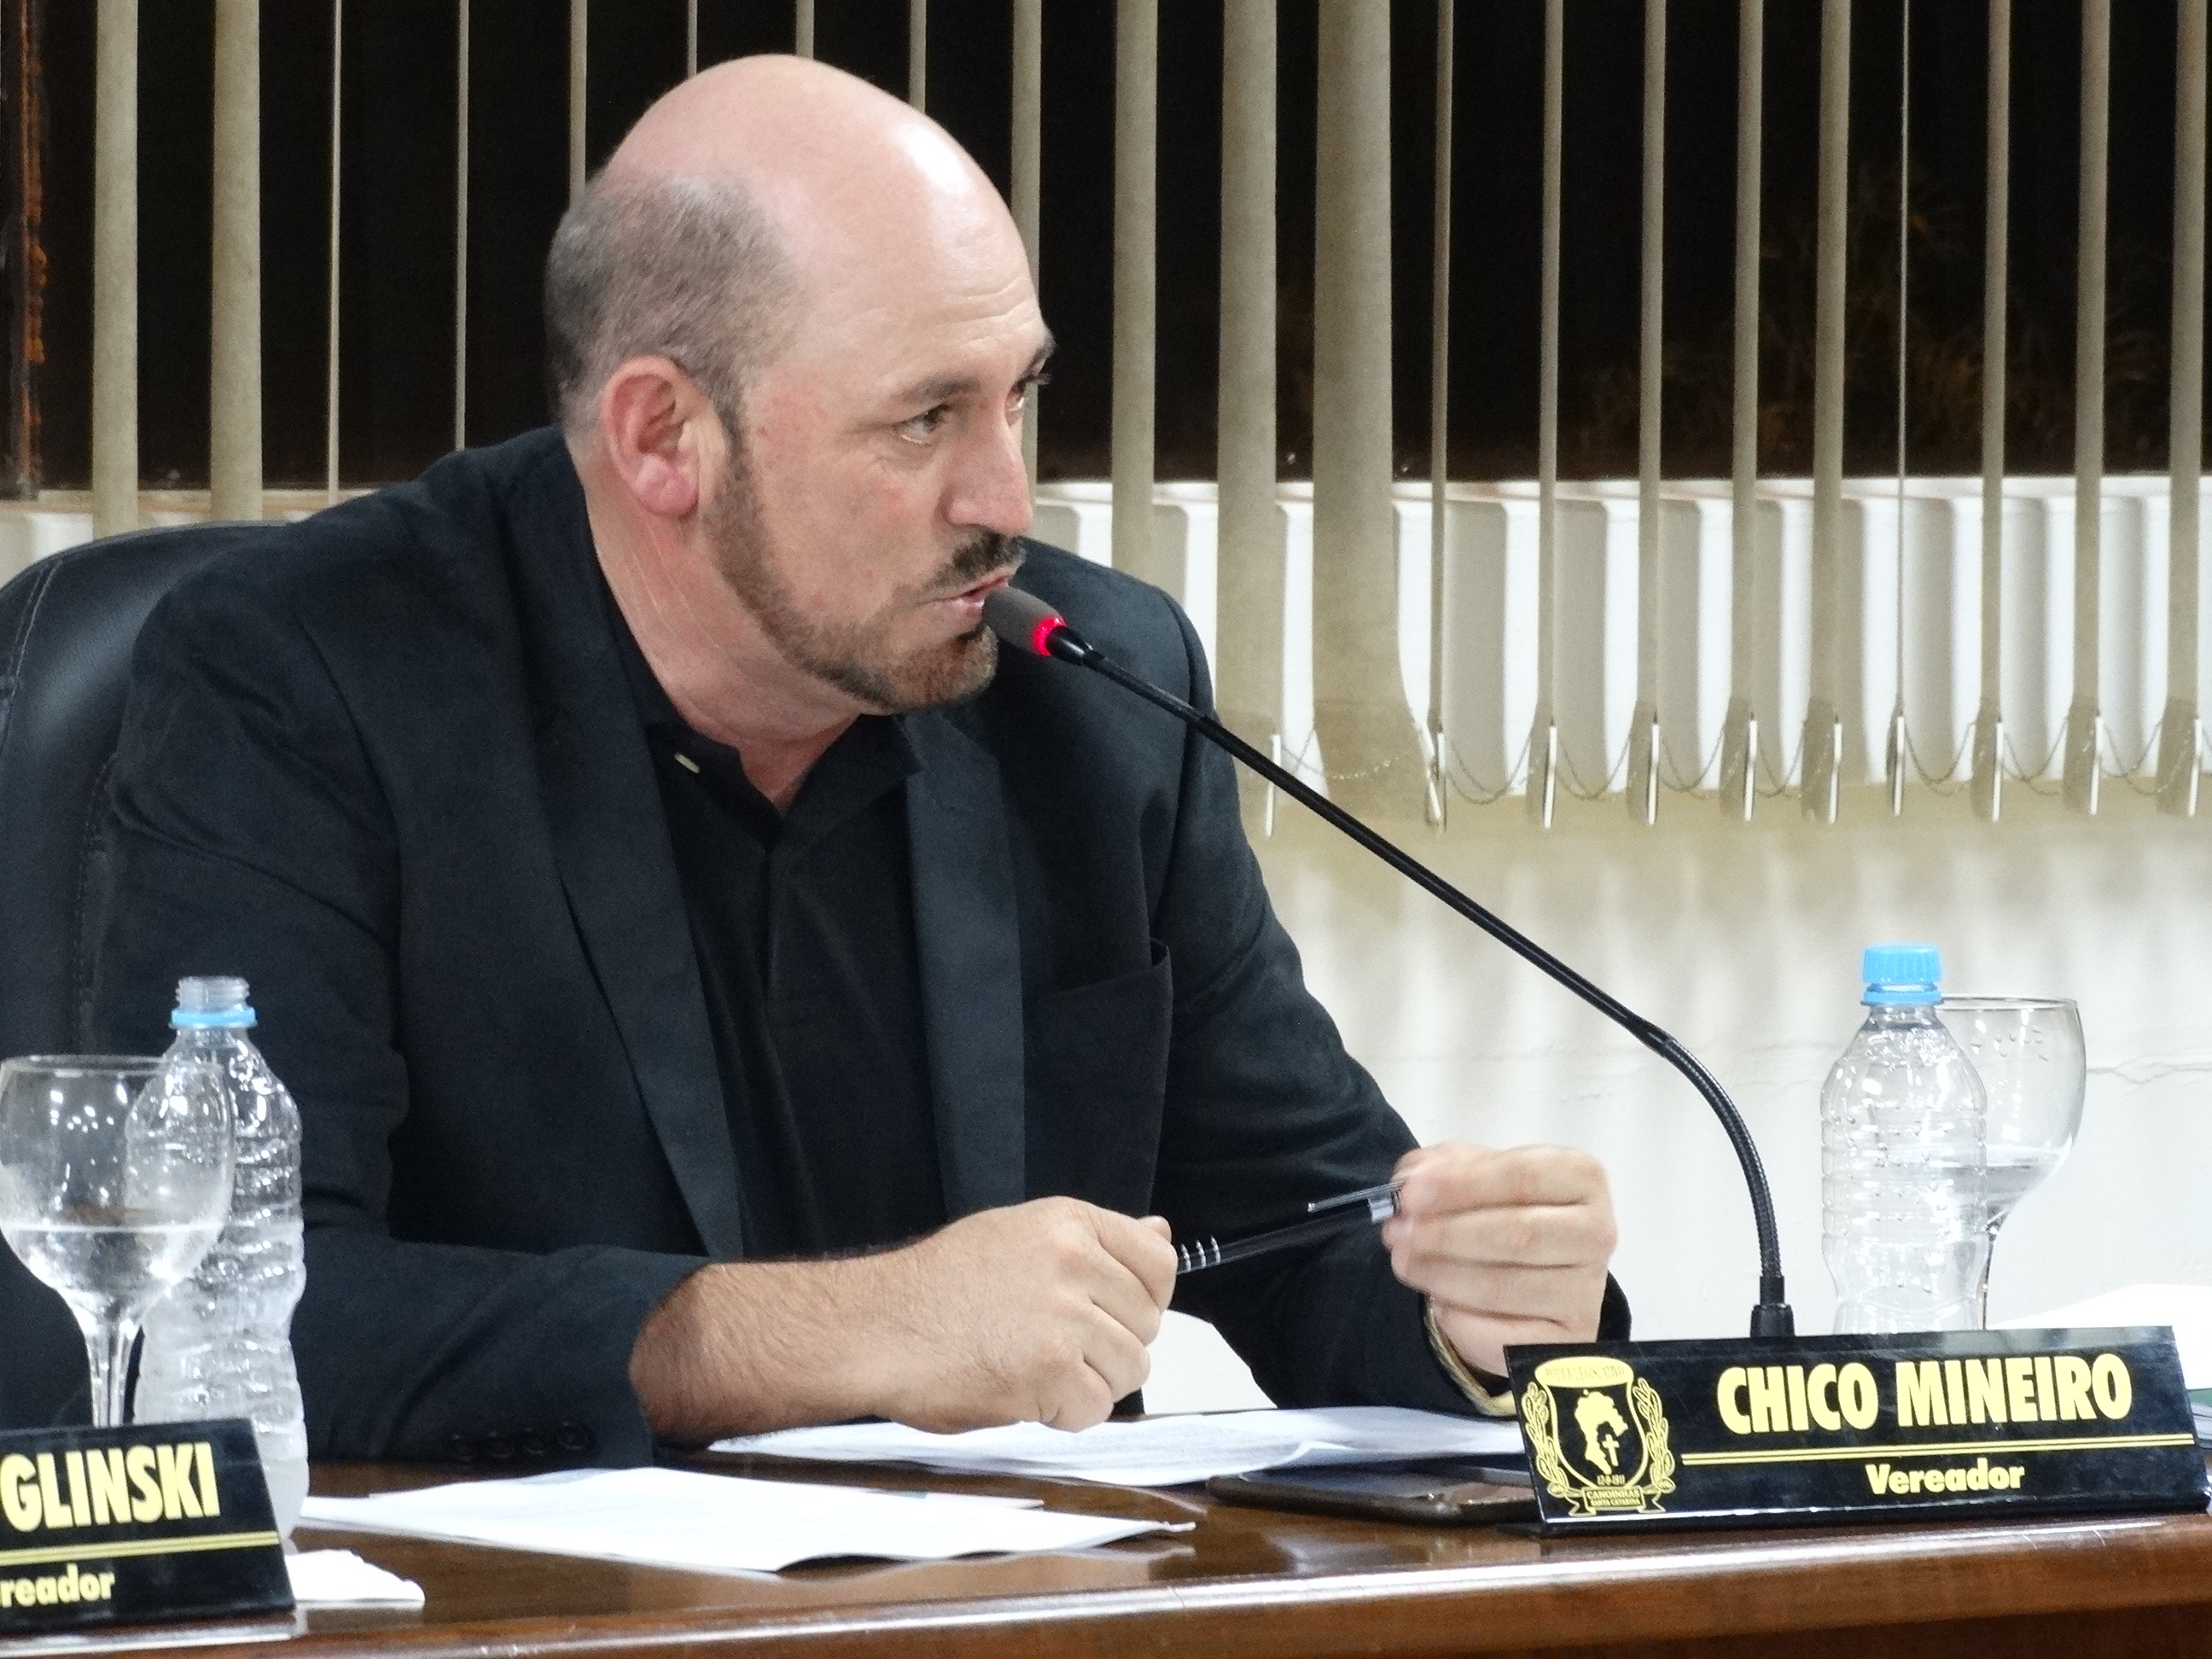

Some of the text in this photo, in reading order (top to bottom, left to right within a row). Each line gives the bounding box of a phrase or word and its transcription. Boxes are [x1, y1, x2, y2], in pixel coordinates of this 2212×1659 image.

[1717, 1353, 2132, 1435] CHICO MINEIRO
[0, 1441, 220, 1532] GLINSKI
[1865, 1458, 2025, 1494] Vereador
